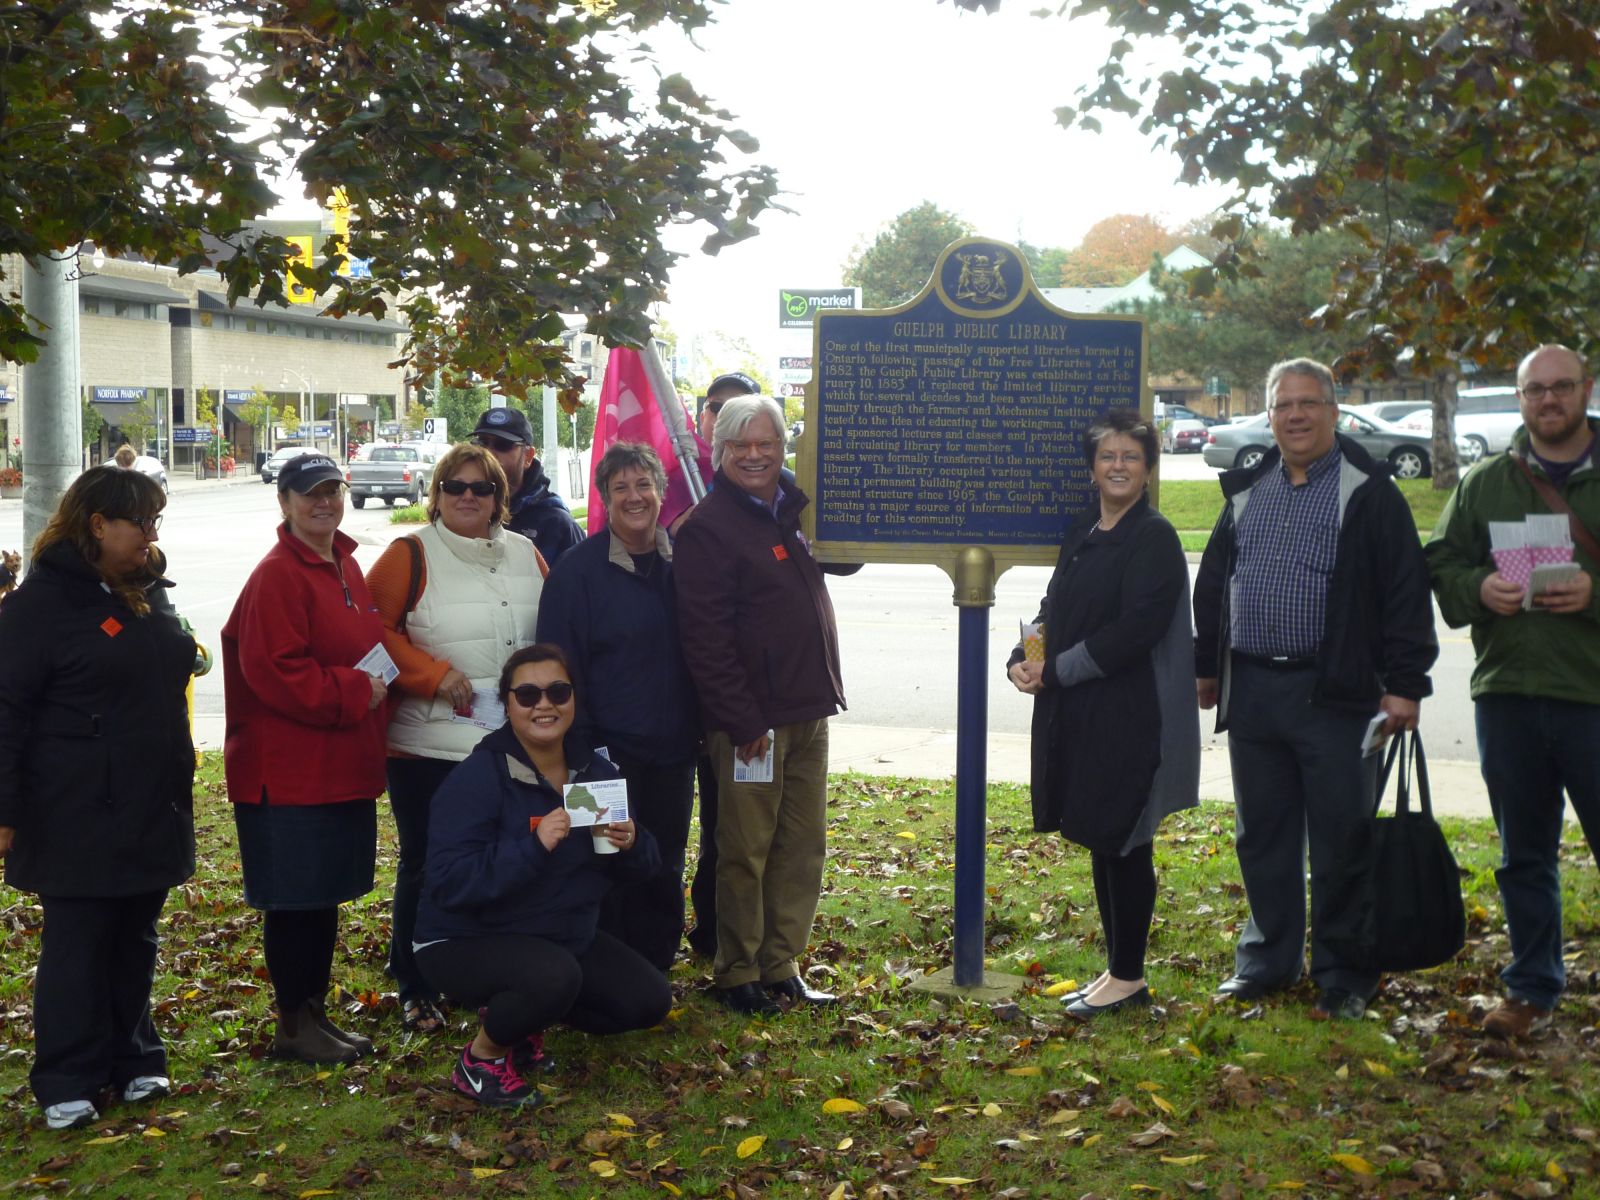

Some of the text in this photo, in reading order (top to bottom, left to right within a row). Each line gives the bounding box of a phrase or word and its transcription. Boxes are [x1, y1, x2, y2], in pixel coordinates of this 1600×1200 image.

[808, 294, 853, 306] market
[893, 323, 1068, 339] GUELPH PUBLIC LIBRARY
[825, 341, 1134, 357] One of the first municipally supported libraries formed in
[825, 354, 1134, 368] Ontario following passage of the Free Libraries Act of
[858, 366, 876, 376] the
[880, 366, 917, 379] Guelph
[923, 367, 955, 377] Public
[961, 367, 1001, 381] Library
[1033, 369, 1092, 379] established
[1096, 372, 1108, 380] on
[97, 388, 119, 399] NORFOLK
[825, 381, 854, 391] ruary
[918, 379, 925, 390] It
[931, 380, 975, 393] replaced
[981, 380, 999, 391] the
[1003, 381, 1042, 391] limited
[1050, 381, 1088, 395] library
[1093, 383, 1134, 393] service
[825, 390, 855, 401] which
[859, 391, 874, 401] for
[878, 391, 915, 401] several
[921, 392, 961, 402] decades
[965, 392, 984, 403] had
[990, 393, 1013, 403] been
[1020, 393, 1067, 404] available
[1073, 394, 1084, 404] to
[1087, 394, 1104, 405] the
[824, 403, 859, 416] munity
[863, 403, 904, 416] through
[908, 404, 924, 414] the
[972, 405, 992, 415] and
[858, 415, 868, 425] to
[871, 415, 887, 425] the
[891, 415, 912, 426] idea
[916, 415, 926, 426] of
[928, 416, 977, 429] educating
[982, 416, 998, 427] the
[1070, 418, 1086, 428] the
[824, 426, 1084, 443] had sponsored lectures and classes and provided a
[824, 439, 842, 449] and
[847, 439, 900, 453] circulating
[904, 440, 942, 453] library
[946, 441, 961, 451] for
[1024, 442, 1035, 452] In
[1040, 442, 1076, 452] March
[823, 452, 856, 462] assets
[859, 454, 883, 462] were
[888, 452, 930, 465] formally
[934, 453, 992, 464] transferred
[994, 454, 1005, 464] to
[1007, 454, 1023, 464] the
[872, 463, 892, 474] The
[897, 464, 934, 477] library
[940, 464, 985, 478] occupied
[991, 466, 1032, 476] various
[1039, 466, 1064, 476] sites
[823, 476, 850, 486] when
[863, 477, 916, 489] permanent
[920, 477, 962, 490] building
[964, 480, 984, 488] was
[988, 477, 1024, 488] erected
[824, 489, 861, 501] present
[866, 489, 913, 499] structure
[919, 490, 944, 500] since
[985, 490, 1001, 501] the
[1008, 491, 1044, 504] Guelph
[1051, 491, 1084, 502] Public
[824, 500, 864, 510] remains
[869, 503, 876, 511] a
[879, 503, 908, 514] major
[914, 504, 948, 512] source
[955, 502, 966, 512] of
[970, 502, 1031, 513] information
[1039, 503, 1059, 513] and
[823, 512, 861, 525] reading
[866, 512, 881, 523] for
[885, 512, 906, 523] this
